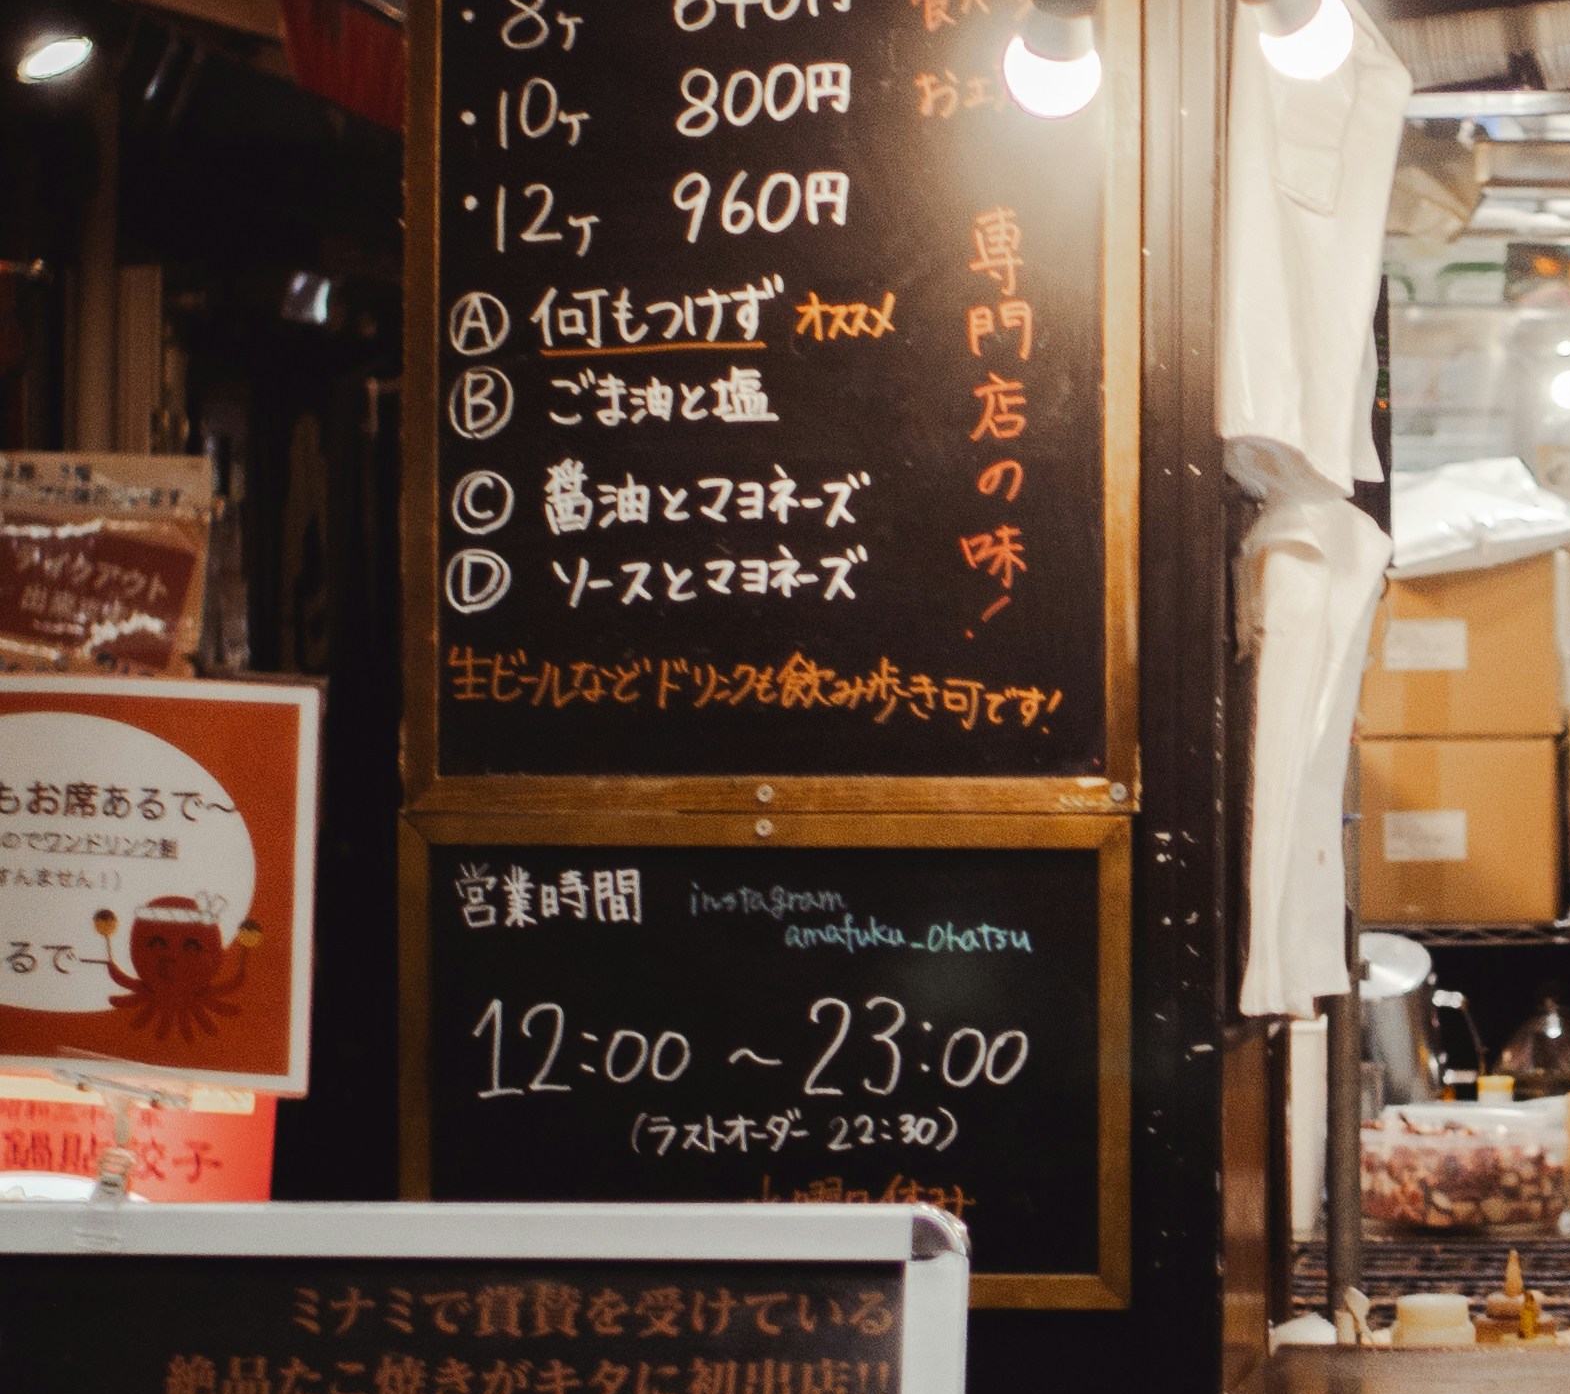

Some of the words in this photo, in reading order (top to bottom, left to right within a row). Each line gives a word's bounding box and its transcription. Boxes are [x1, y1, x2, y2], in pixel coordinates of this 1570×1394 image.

[674, 62, 851, 137] 800円
[673, 170, 850, 244] 960円
[529, 273, 784, 345] 何もつけず
[547, 365, 780, 426] ごま油と塩
[544, 458, 871, 536] 醤油とマヨネーズ
[551, 544, 868, 608] ソースとマヨネーズ
[455, 861, 642, 928] 営業時間
[471, 999, 692, 1099] 12:00
[803, 996, 1029, 1097] 23:00
[290, 1282, 897, 1341] ミナミで賞賛を受けている
